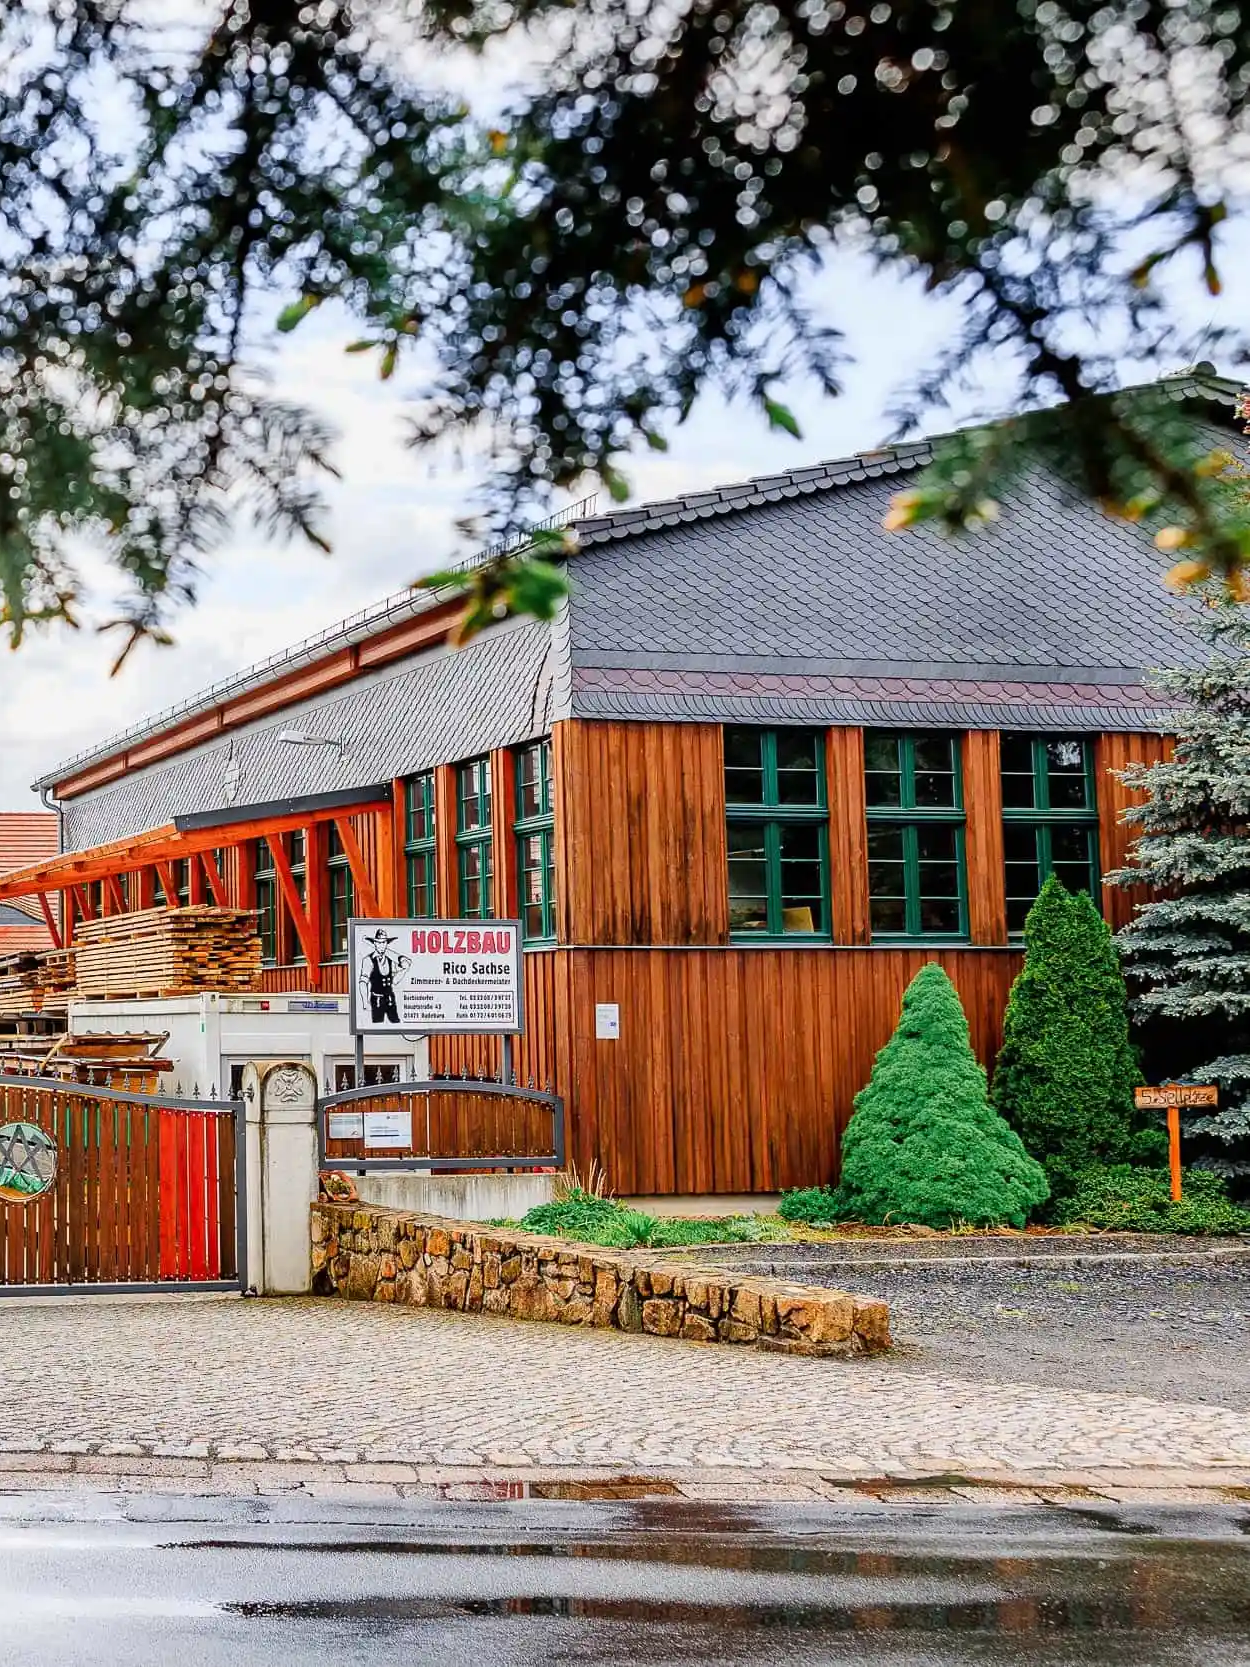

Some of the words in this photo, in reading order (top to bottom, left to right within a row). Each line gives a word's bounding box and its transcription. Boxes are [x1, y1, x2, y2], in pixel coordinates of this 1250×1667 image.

[411, 930, 511, 954] HOLZBAU
[443, 961, 467, 975] Rico
[471, 961, 511, 974] Sachse
[452, 977, 511, 985] Dachdeckermeister
